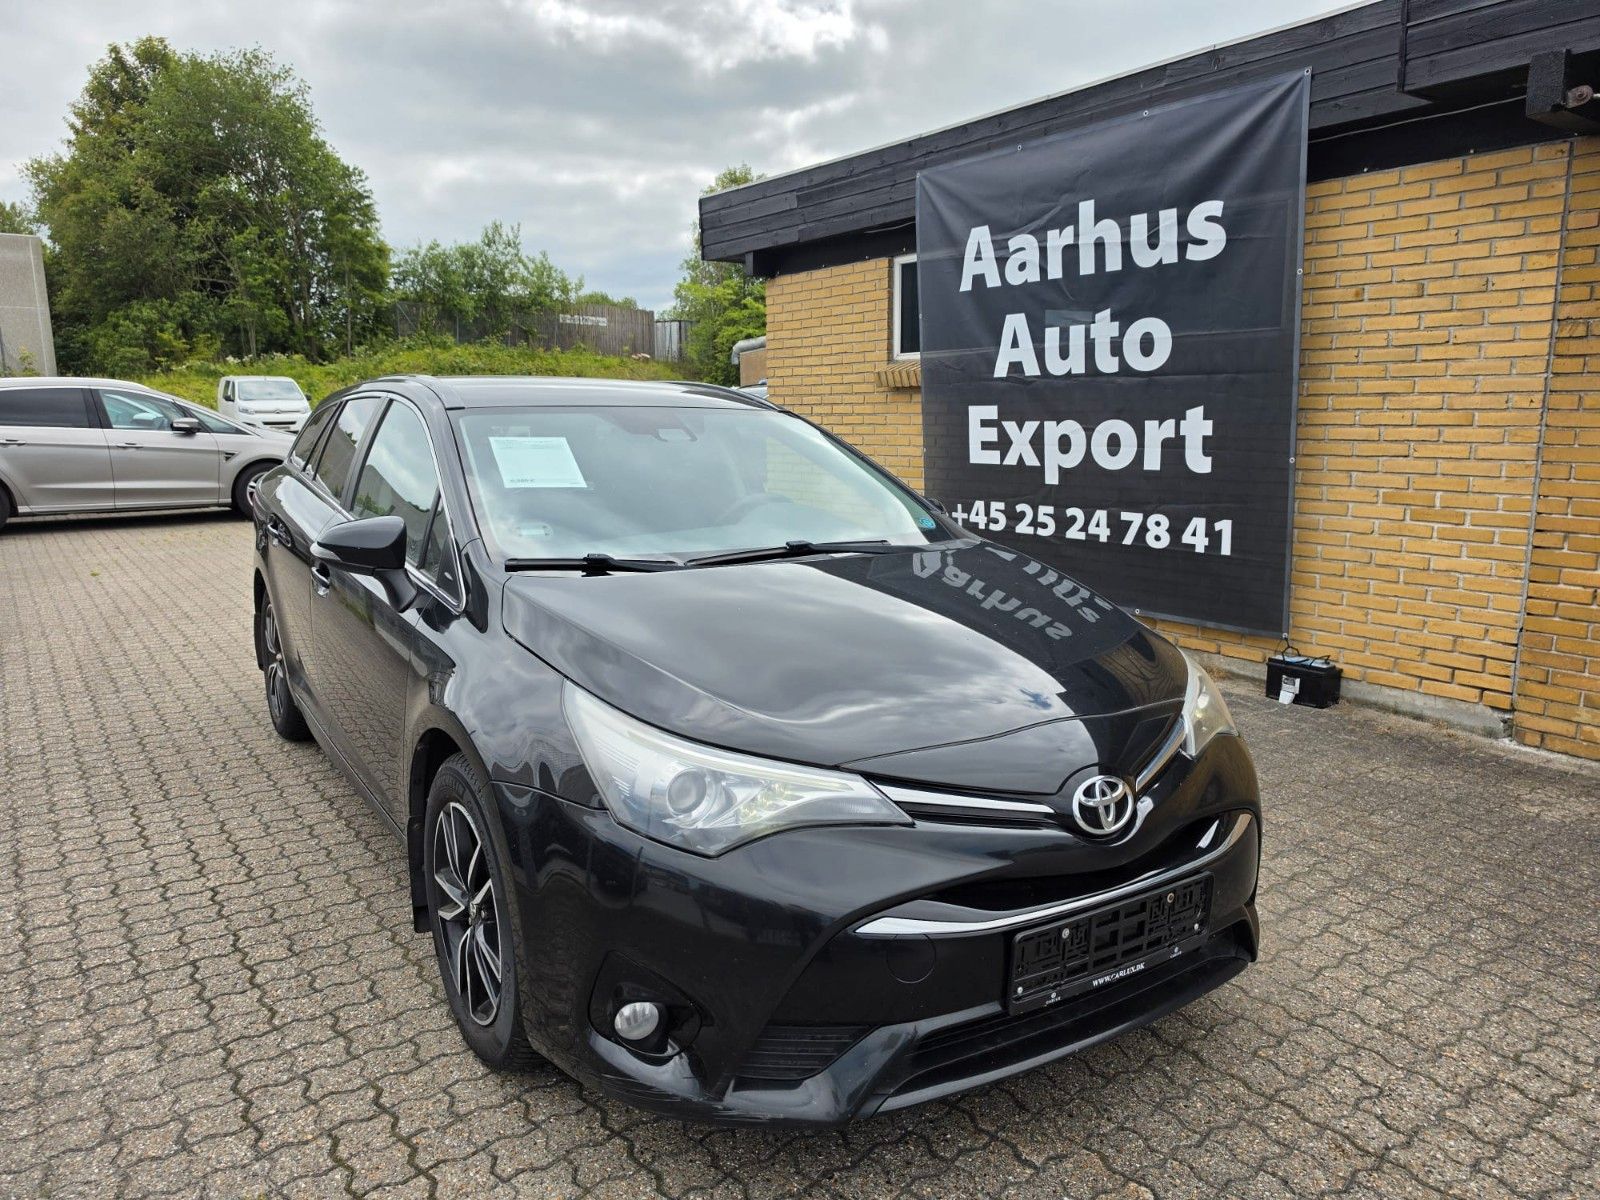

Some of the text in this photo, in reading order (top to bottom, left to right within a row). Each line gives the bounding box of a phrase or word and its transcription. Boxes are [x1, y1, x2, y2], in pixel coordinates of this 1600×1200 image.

[959, 199, 1227, 293] Aarhus
[993, 307, 1173, 378] Auto
[968, 405, 1213, 485] Export
[951, 500, 1232, 556] +45 25 24 78 41
